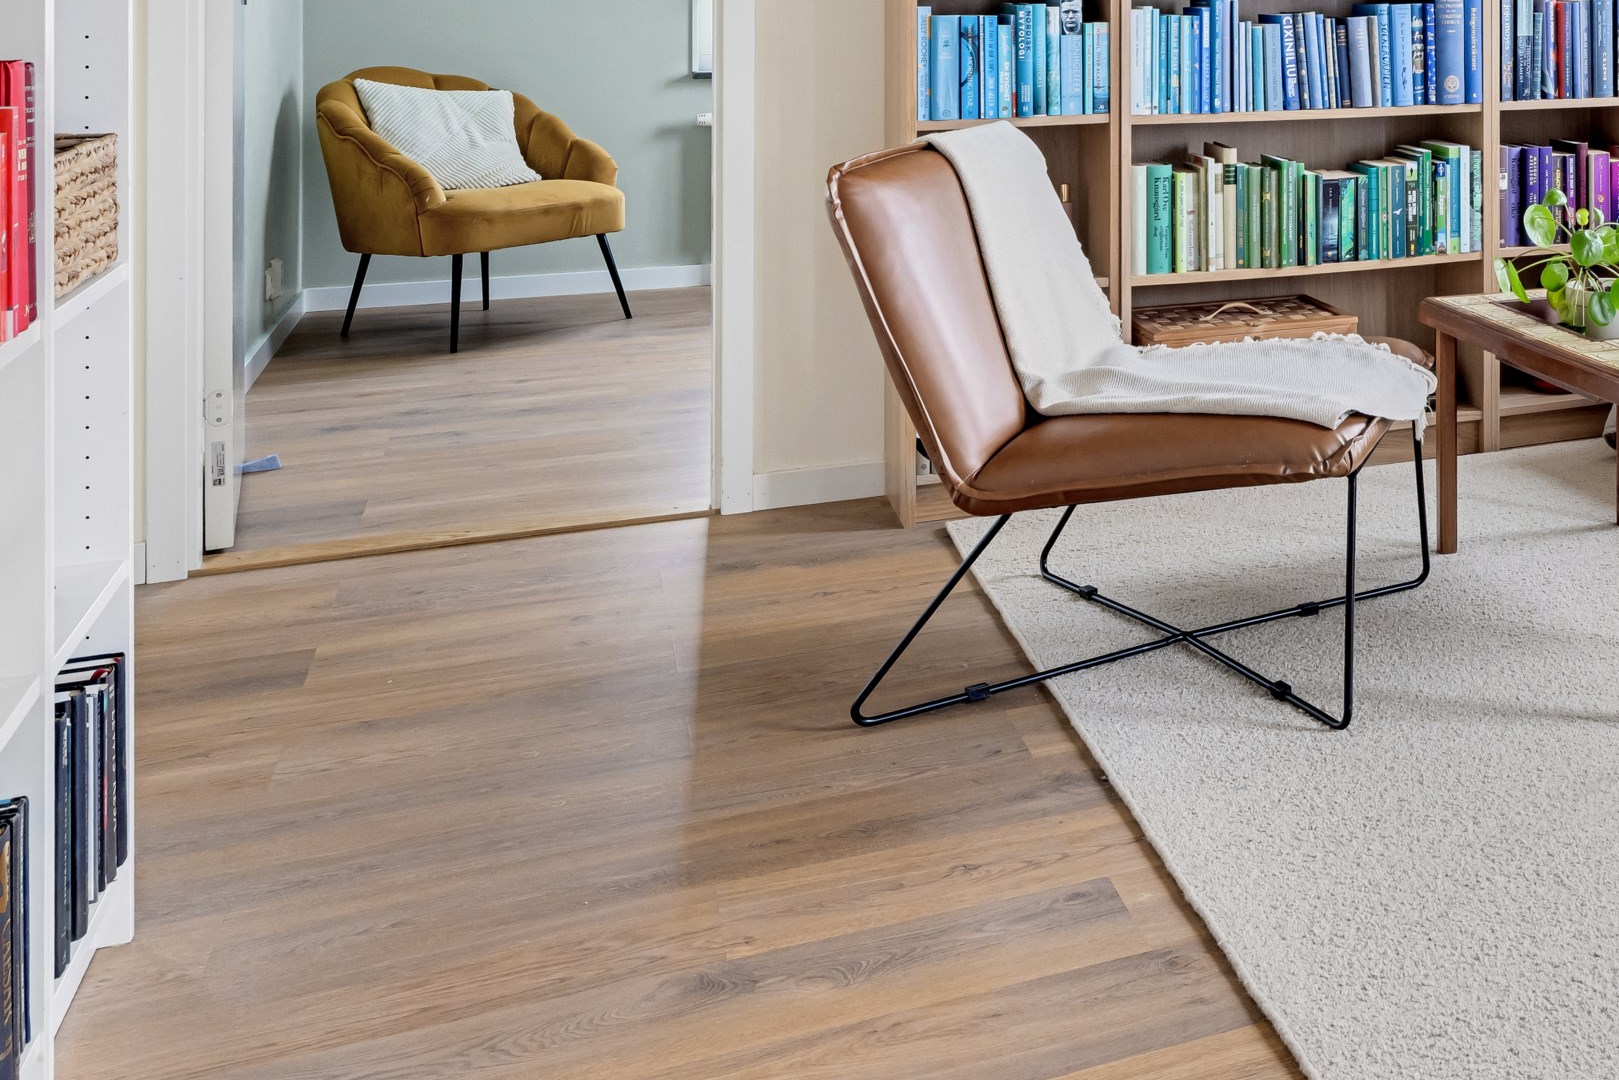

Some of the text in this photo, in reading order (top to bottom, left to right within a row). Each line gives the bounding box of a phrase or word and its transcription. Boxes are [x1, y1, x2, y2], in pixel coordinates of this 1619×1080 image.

[920, 14, 928, 68] SALLY ROONEY
[1072, 36, 1080, 93] BONHOEFFER
[1283, 16, 1297, 77] CIXIN LIU
[1470, 7, 1478, 71] Religionslexikonet
[1503, 23, 1511, 50] moyes
